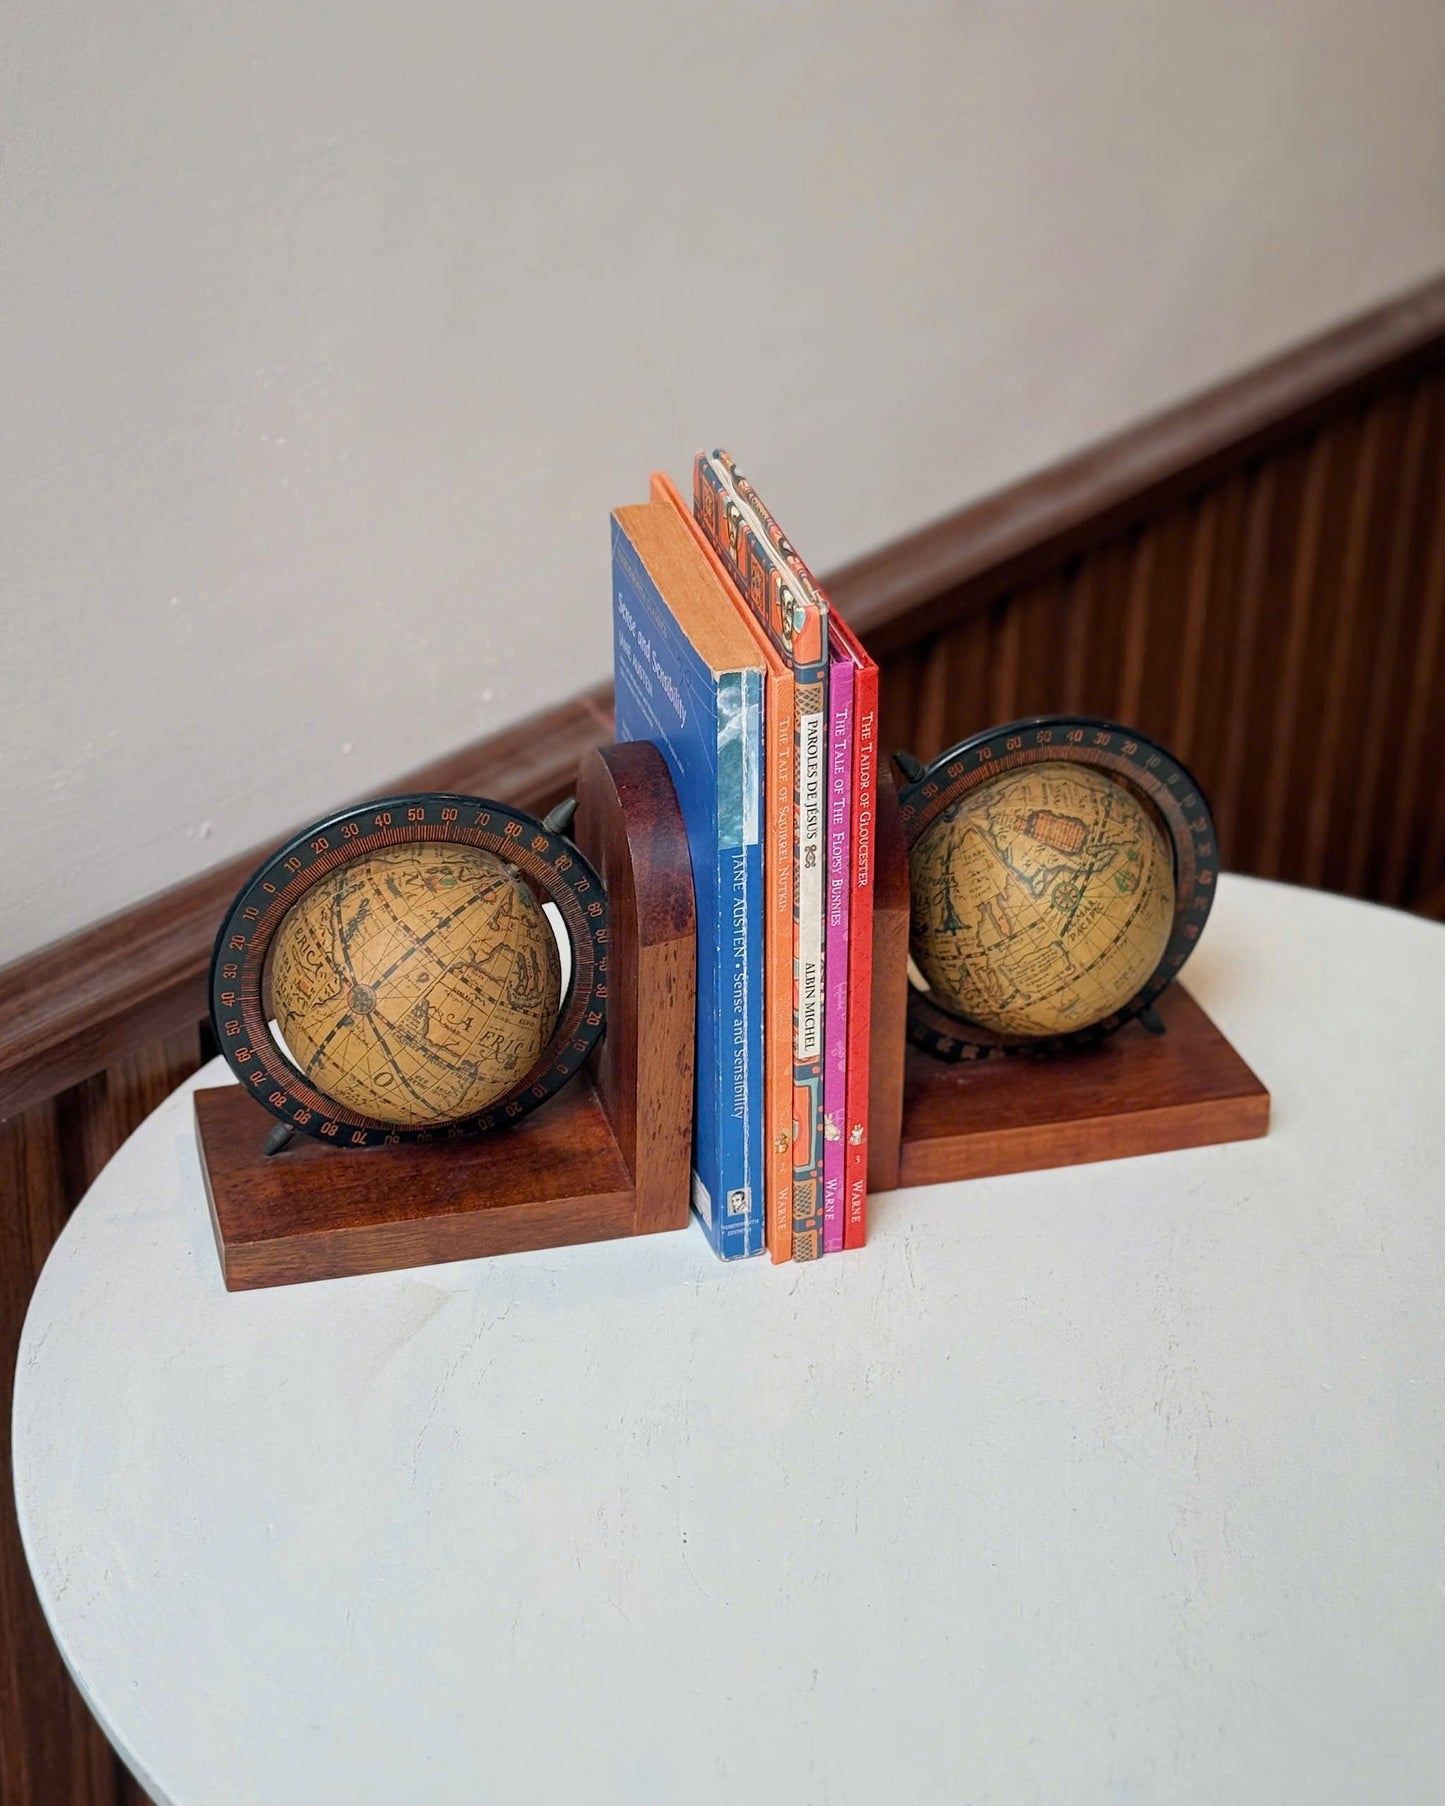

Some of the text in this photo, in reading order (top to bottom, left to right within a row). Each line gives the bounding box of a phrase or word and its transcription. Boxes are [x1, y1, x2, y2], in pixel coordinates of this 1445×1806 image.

[638, 631, 651, 662] and
[652, 651, 686, 728] Sensibility
[1067, 729, 1084, 743] 40
[1093, 732, 1111, 746] 30
[807, 720, 819, 779] PAROLES
[976, 747, 992, 762] 70
[1121, 740, 1138, 755] 20
[1145, 754, 1161, 768] 10
[807, 781, 818, 800] DE
[858, 712, 874, 888] THE TAILOR OF GLOUCESTER
[374, 812, 392, 826] 40
[407, 807, 425, 821] 50
[441, 808, 458, 822] 60
[474, 811, 491, 826] 70
[778, 717, 790, 912] THE TALE OF SQUIRREL NUTKIN
[831, 709, 848, 927] THE TALE OF THE FLOPSY BUNNIES
[341, 823, 359, 838] 30
[504, 821, 523, 837] 80
[311, 837, 330, 854] 20
[531, 836, 550, 853] 90
[284, 856, 301, 872] 10
[554, 854, 573, 872] 80
[262, 882, 276, 893] 0
[574, 876, 590, 893] 70
[243, 907, 260, 921] 10
[229, 934, 246, 950] 20
[223, 963, 238, 979] 30
[730, 854, 746, 1119] JANE AUSTEN Sense and Sensibility
[221, 992, 235, 1007] 40
[804, 963, 815, 1051] ALBIN MICHEL
[585, 1010, 603, 1026] 20
[224, 1019, 240, 1036] 50
[572, 1040, 589, 1052] 10
[234, 1047, 251, 1063] 60
[250, 1070, 267, 1086] 70
[556, 1065, 569, 1075] 0
[268, 1091, 287, 1108] 80
[532, 1086, 548, 1098] 10
[293, 1109, 311, 1125] 90
[505, 1101, 523, 1117] 20
[320, 1121, 339, 1136] 80
[351, 1131, 368, 1145] 70
[824, 1177, 837, 1221] WARNE
[851, 1180, 863, 1223] WARNE
[777, 1187, 789, 1230] WARNE
